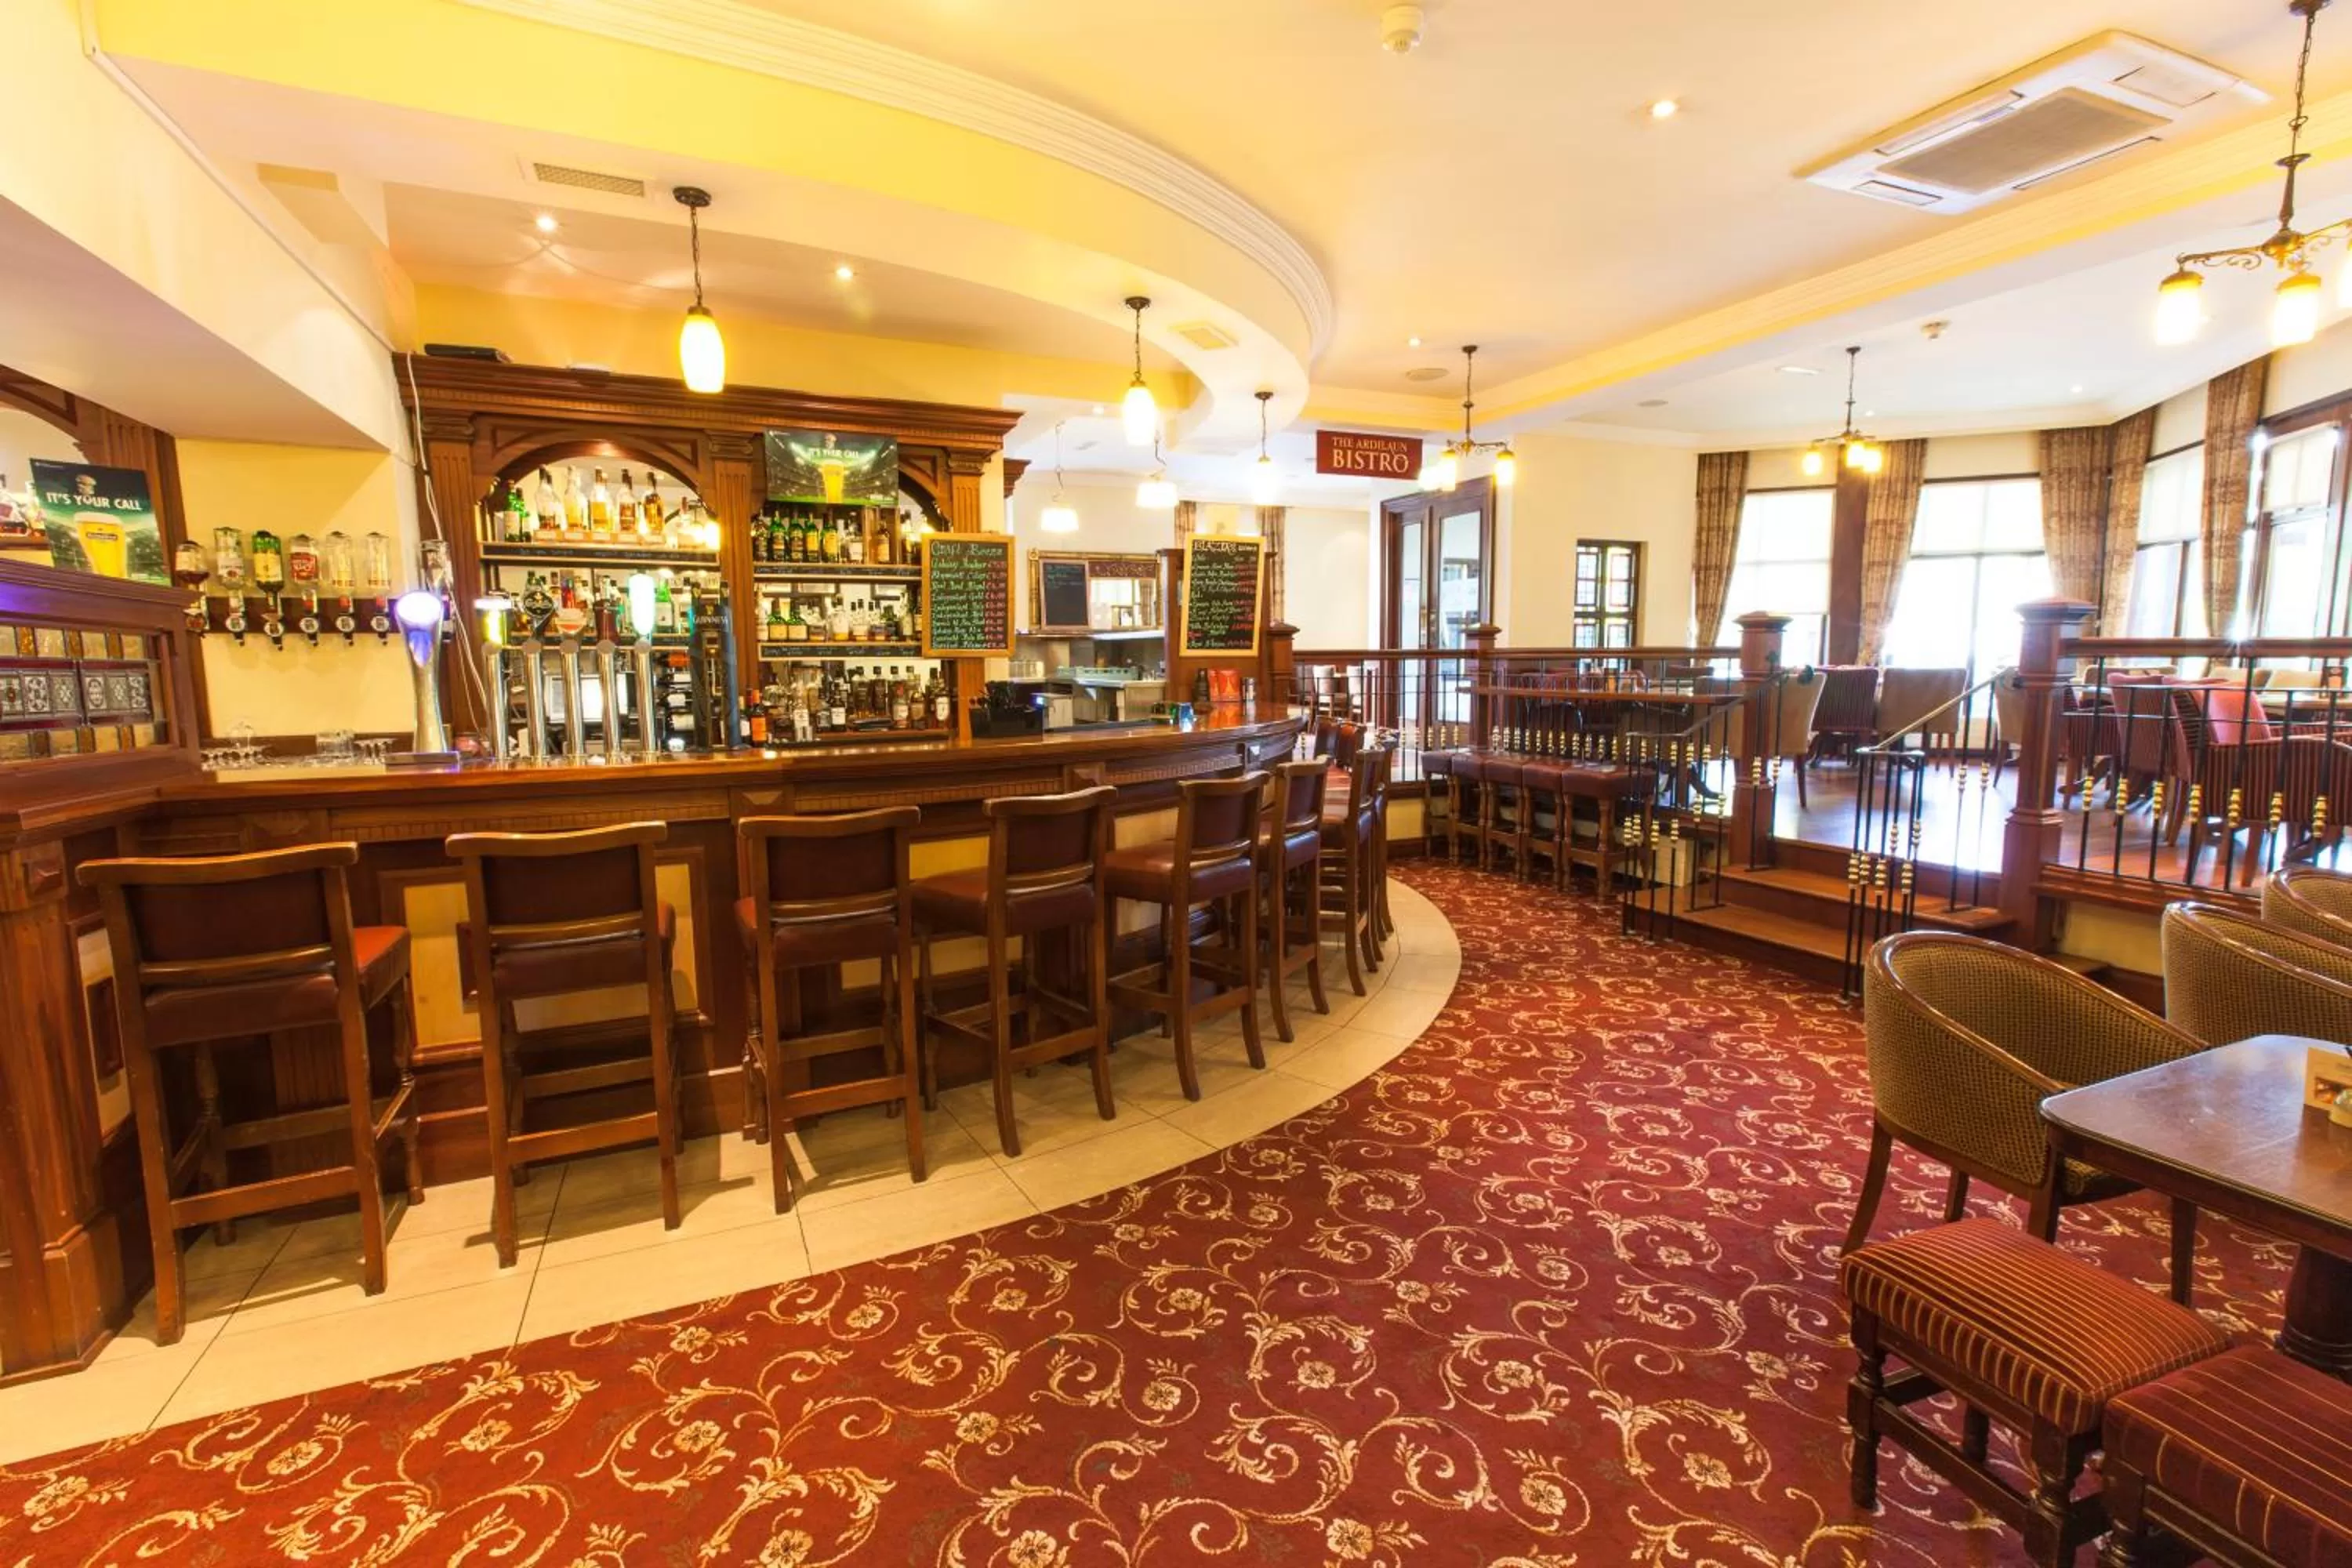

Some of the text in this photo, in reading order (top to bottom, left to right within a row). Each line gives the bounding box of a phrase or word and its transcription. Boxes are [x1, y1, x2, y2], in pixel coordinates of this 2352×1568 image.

[1332, 436, 1408, 454] THE ARDILAUN
[1333, 448, 1410, 473] BISTRO
[46, 492, 143, 511] IT'S YOUR CALL
